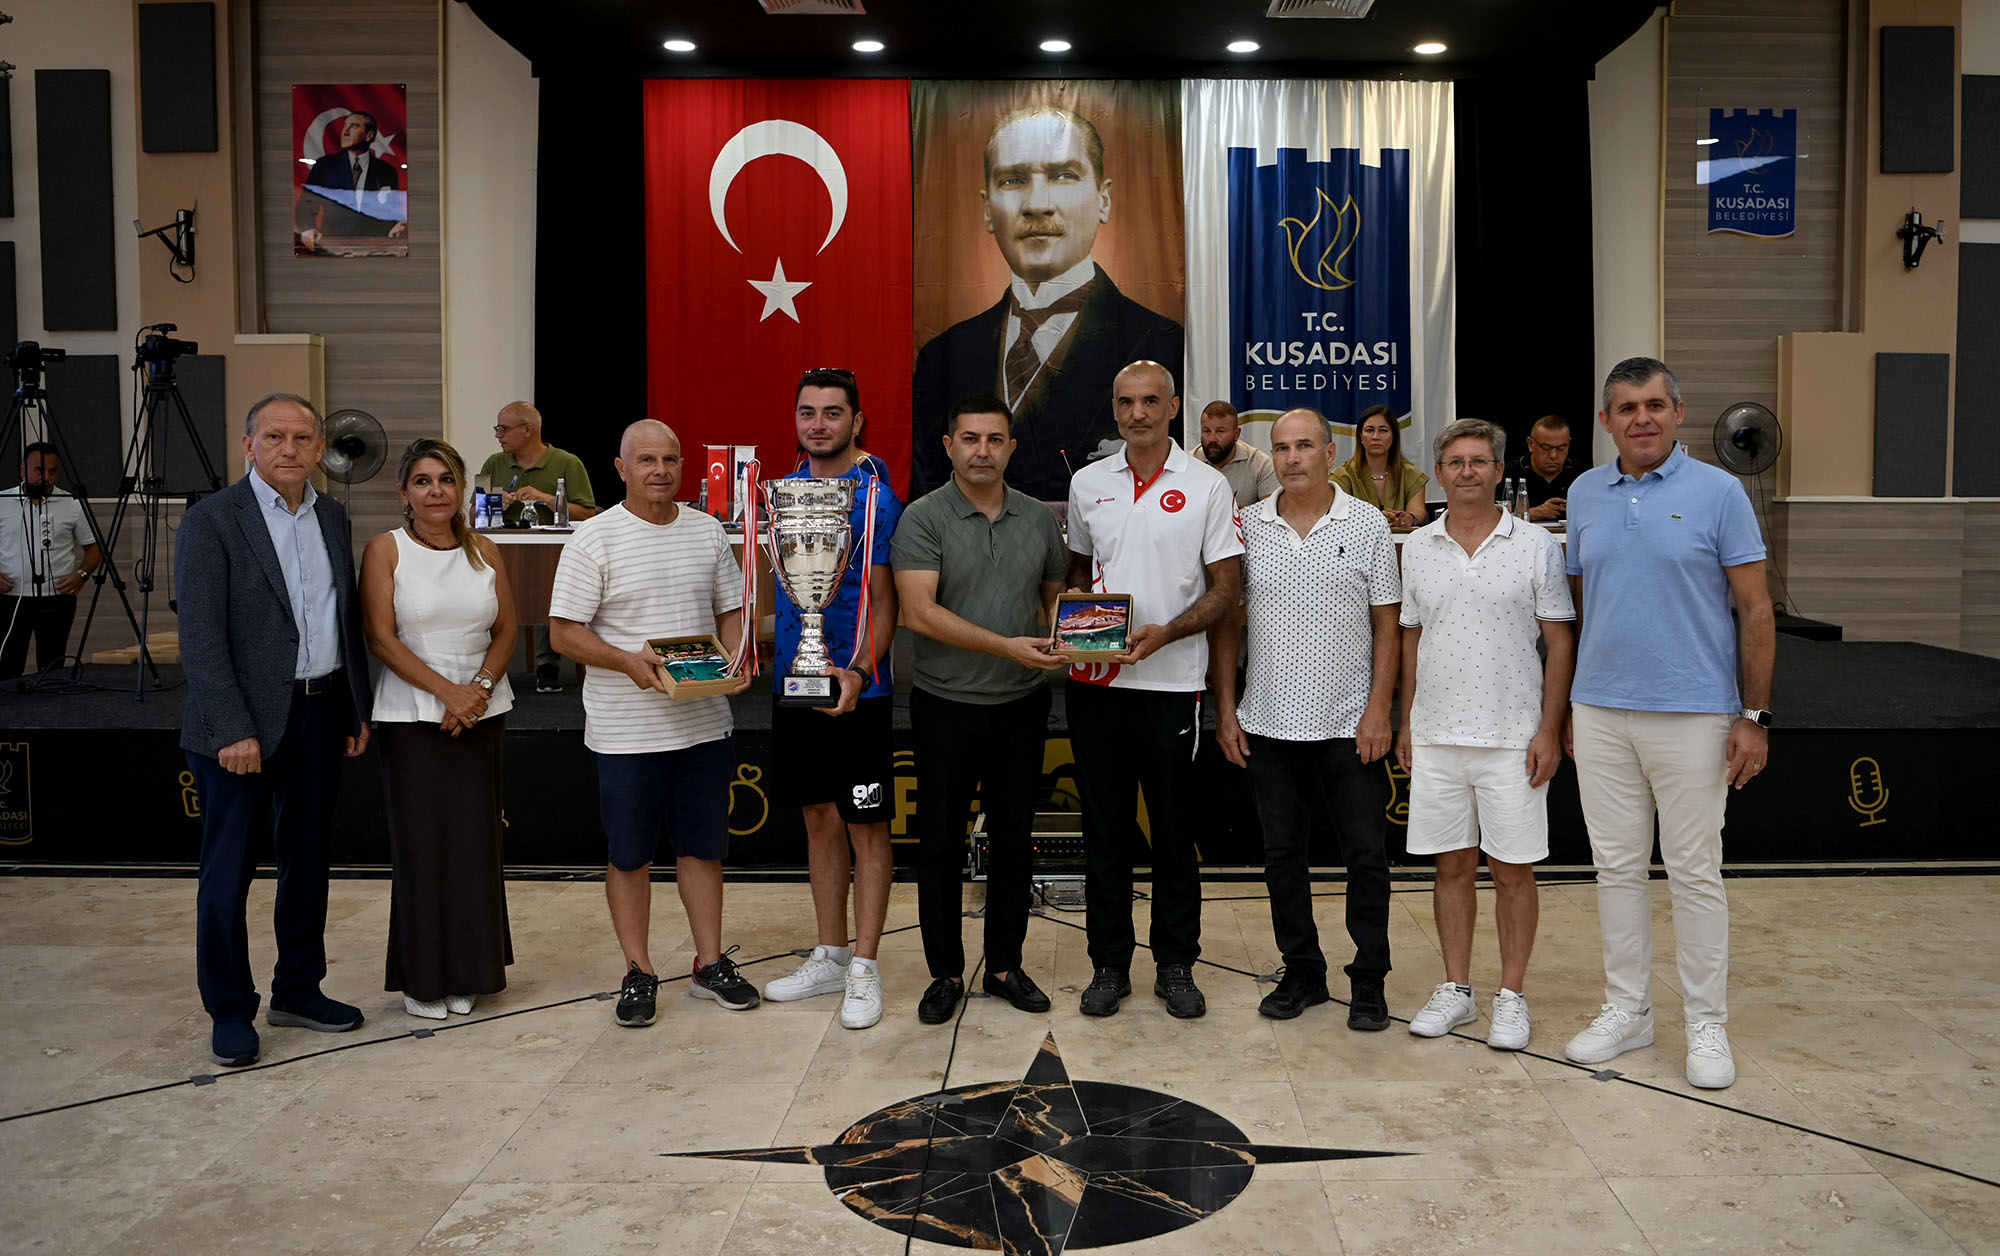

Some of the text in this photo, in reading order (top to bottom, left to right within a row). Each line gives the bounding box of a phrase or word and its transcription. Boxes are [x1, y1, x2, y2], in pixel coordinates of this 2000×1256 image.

[1743, 184, 1764, 194] T.C.
[1715, 197, 1789, 209] KUŞADASI
[1715, 211, 1789, 221] BELEDİYESİ
[1302, 312, 1345, 331] T.C.
[1246, 341, 1397, 367] KUŞADASI
[1246, 370, 1397, 390] BELEDİYESİ
[852, 782, 883, 806] 90
[0, 811, 27, 821] DASI
